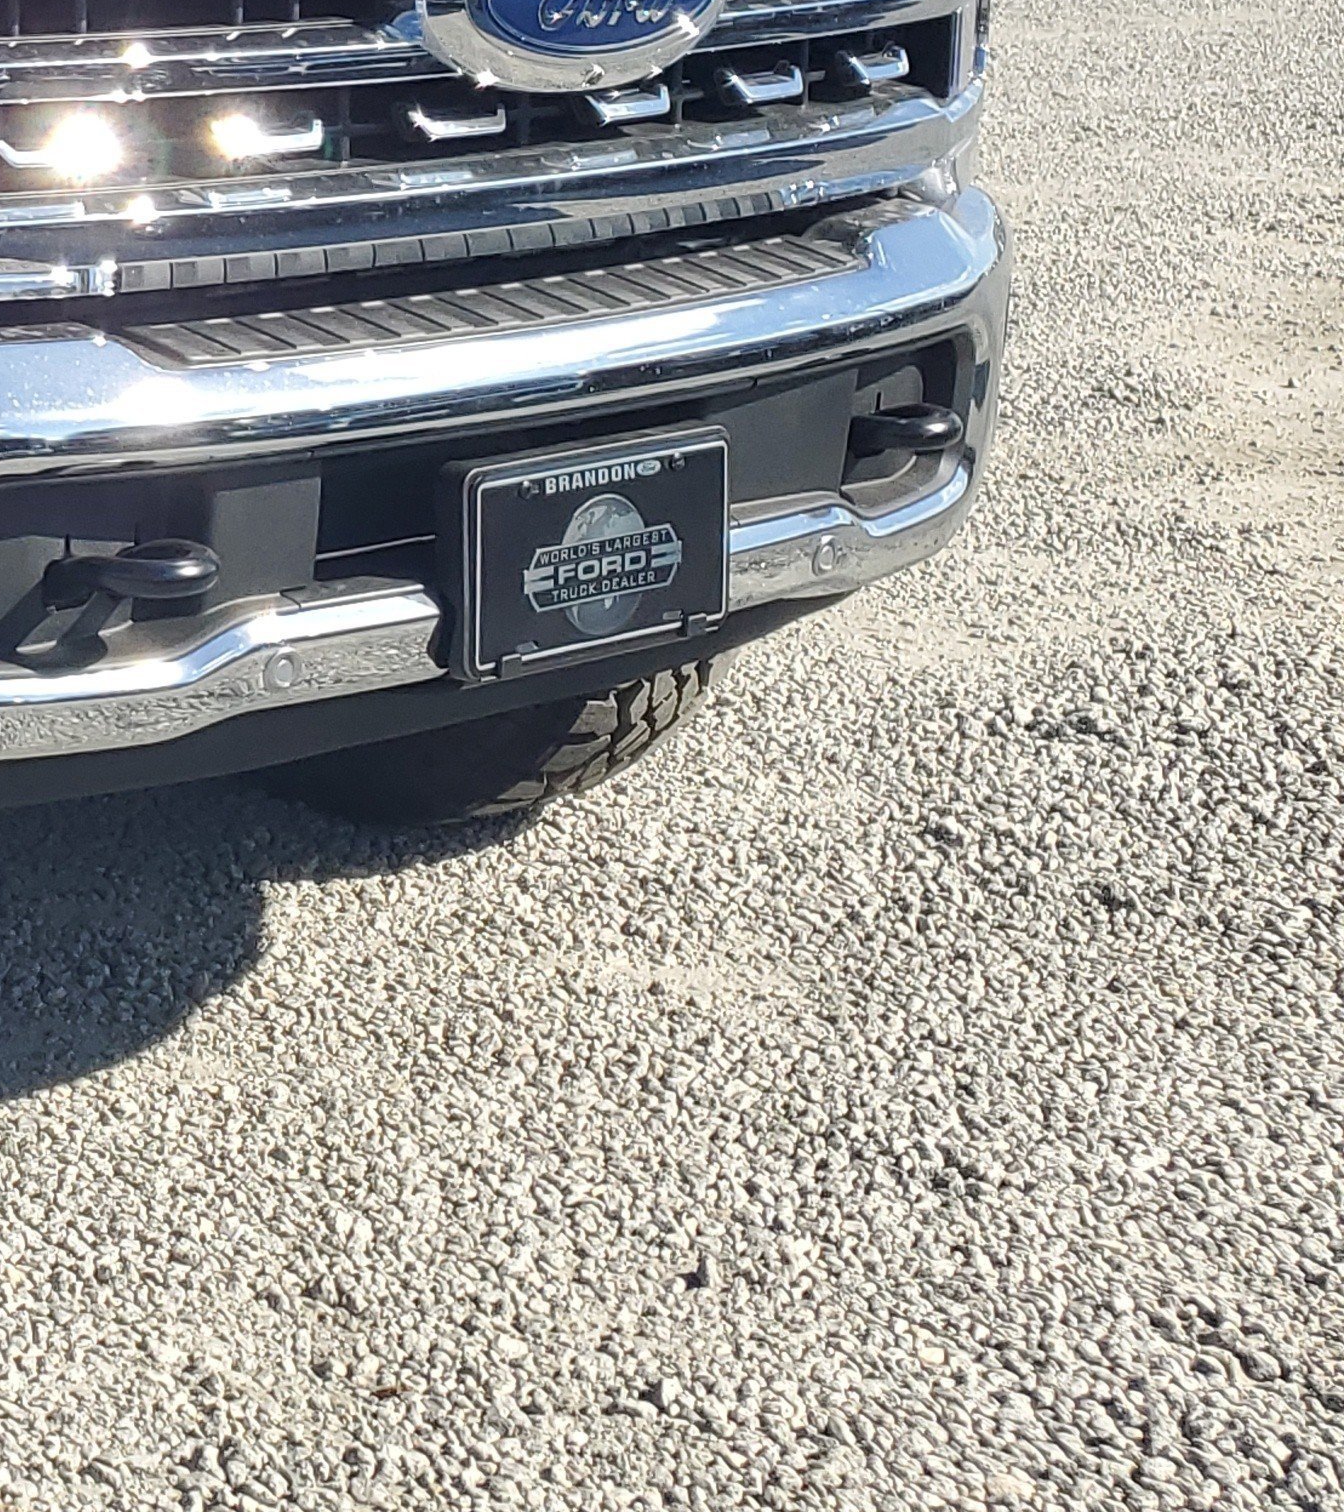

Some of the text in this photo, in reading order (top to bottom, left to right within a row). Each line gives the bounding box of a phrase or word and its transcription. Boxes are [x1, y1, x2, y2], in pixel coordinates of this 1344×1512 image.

[545, 463, 636, 495] BRANDON
[540, 530, 669, 565] WORLD'S LARGEST
[558, 550, 646, 586] FORD
[551, 570, 656, 603] TRUCK DEALER
